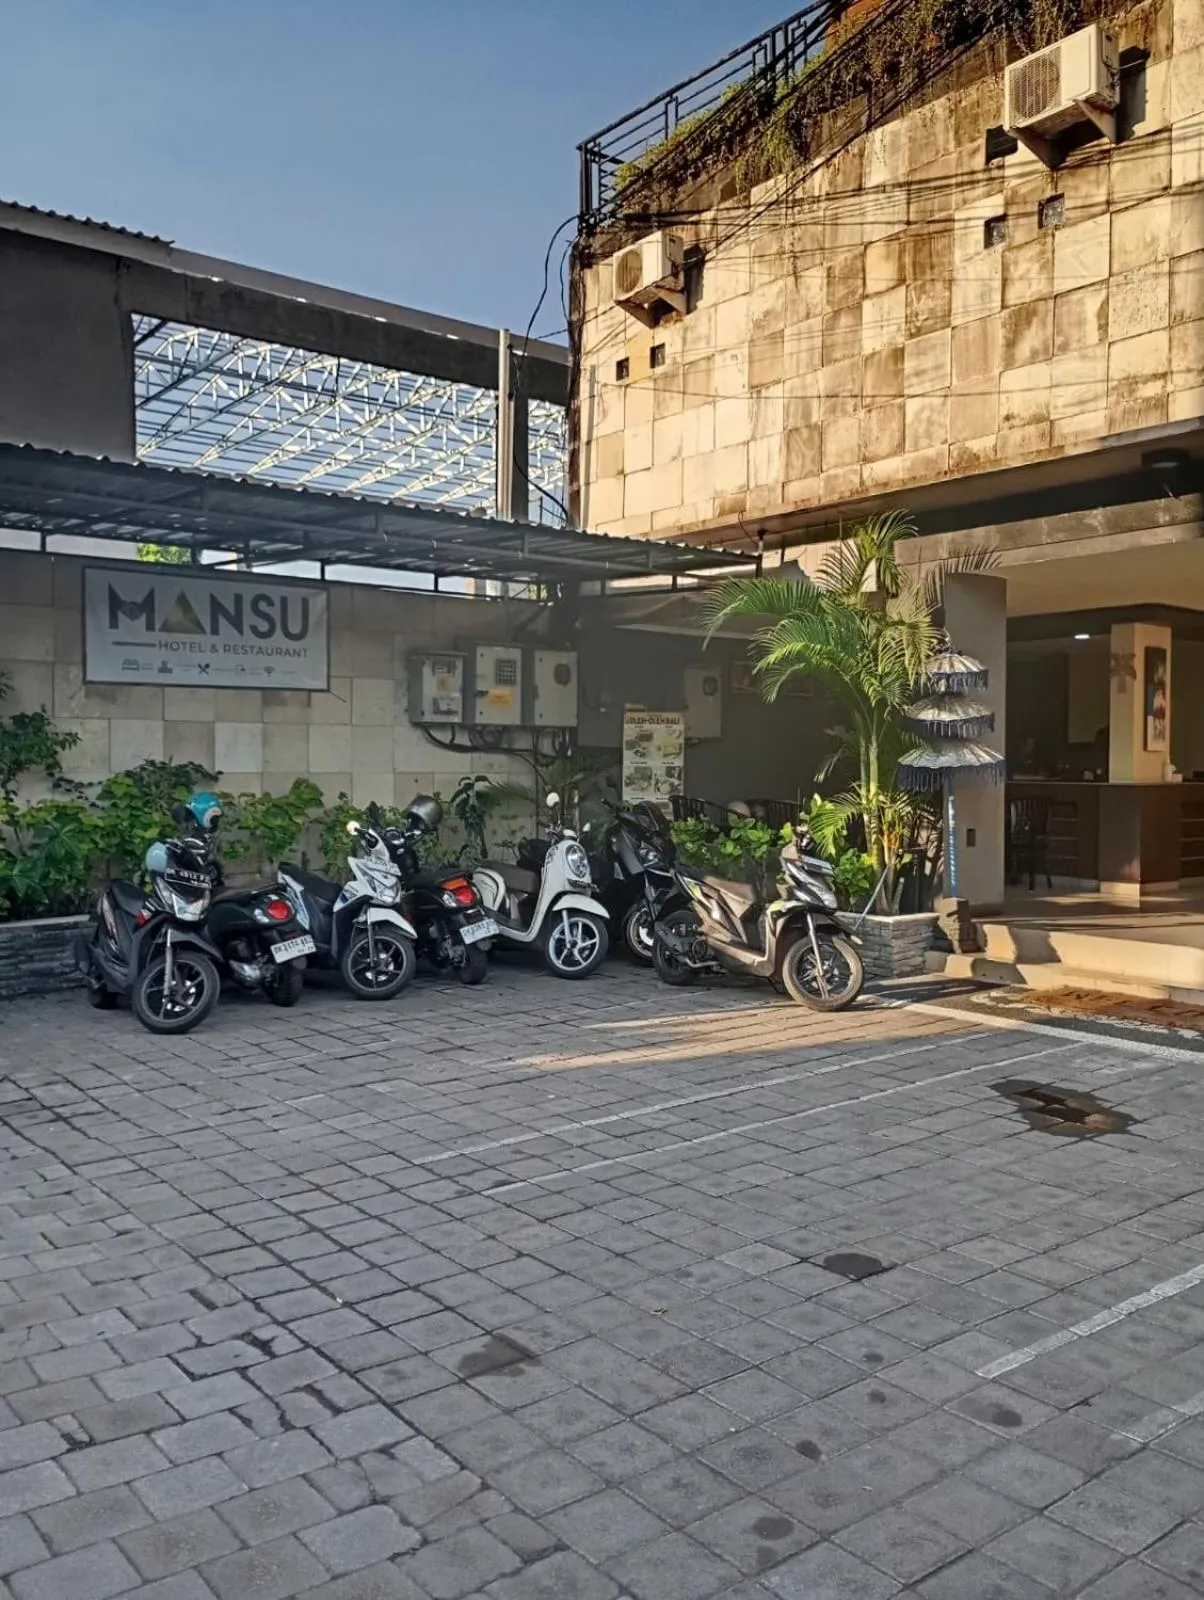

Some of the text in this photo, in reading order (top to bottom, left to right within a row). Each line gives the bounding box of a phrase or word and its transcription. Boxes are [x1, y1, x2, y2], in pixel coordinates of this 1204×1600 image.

[107, 582, 310, 642] MANSU
[158, 640, 308, 658] HOTEL & RESTAURANT
